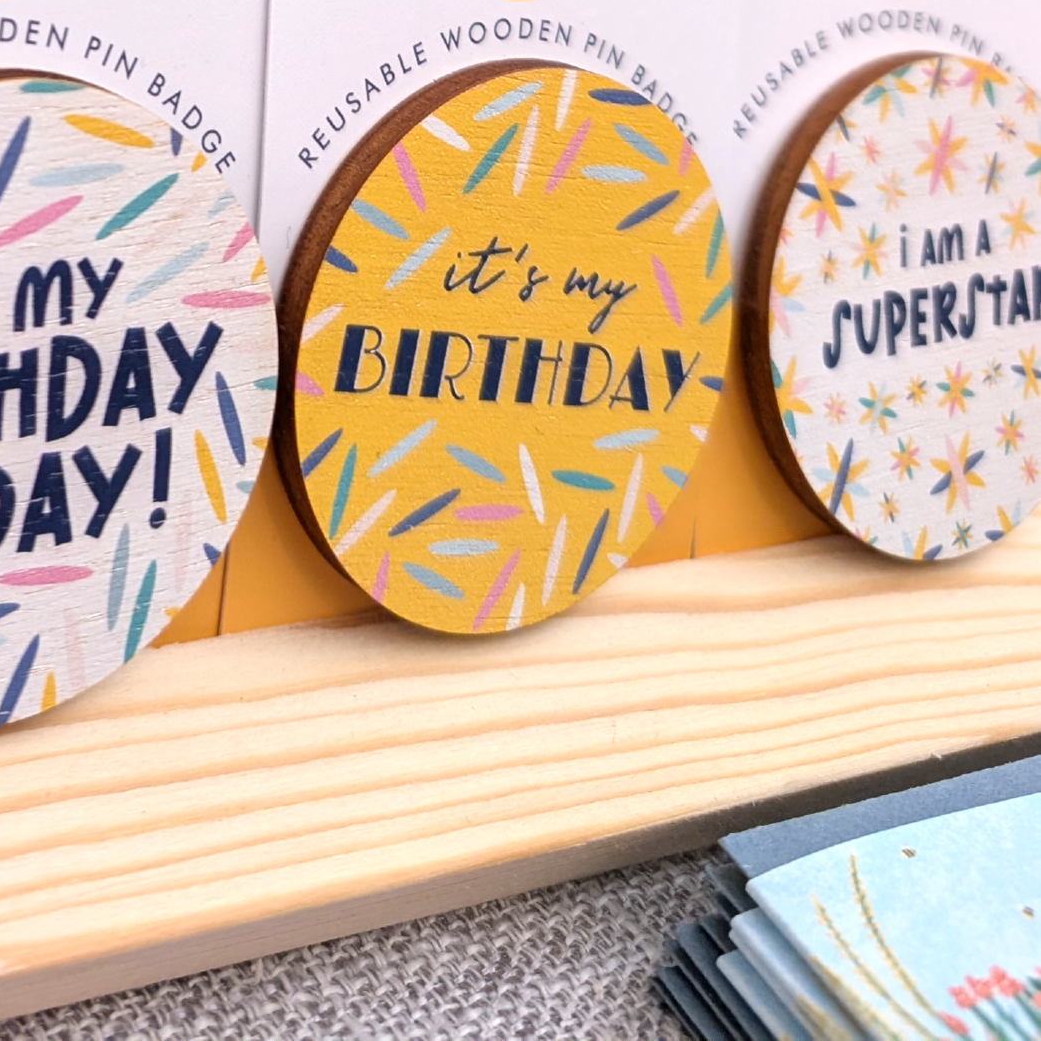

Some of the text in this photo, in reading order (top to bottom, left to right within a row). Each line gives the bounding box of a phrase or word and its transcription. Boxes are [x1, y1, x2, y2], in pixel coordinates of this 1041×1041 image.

[84, 36, 139, 80] PIN
[147, 72, 236, 175] BADGE
[298, 42, 427, 169] REUSABLE
[440, 17, 573, 52] WOODEN
[584, 32, 625, 70] PIN
[732, 10, 984, 140] REUSABLE WOODEN PIN
[443, 236, 638, 335] it's my
[920, 223, 964, 267] AM
[975, 219, 992, 256] A
[13, 256, 124, 332] MY
[333, 323, 701, 412] BIRTHDAY
